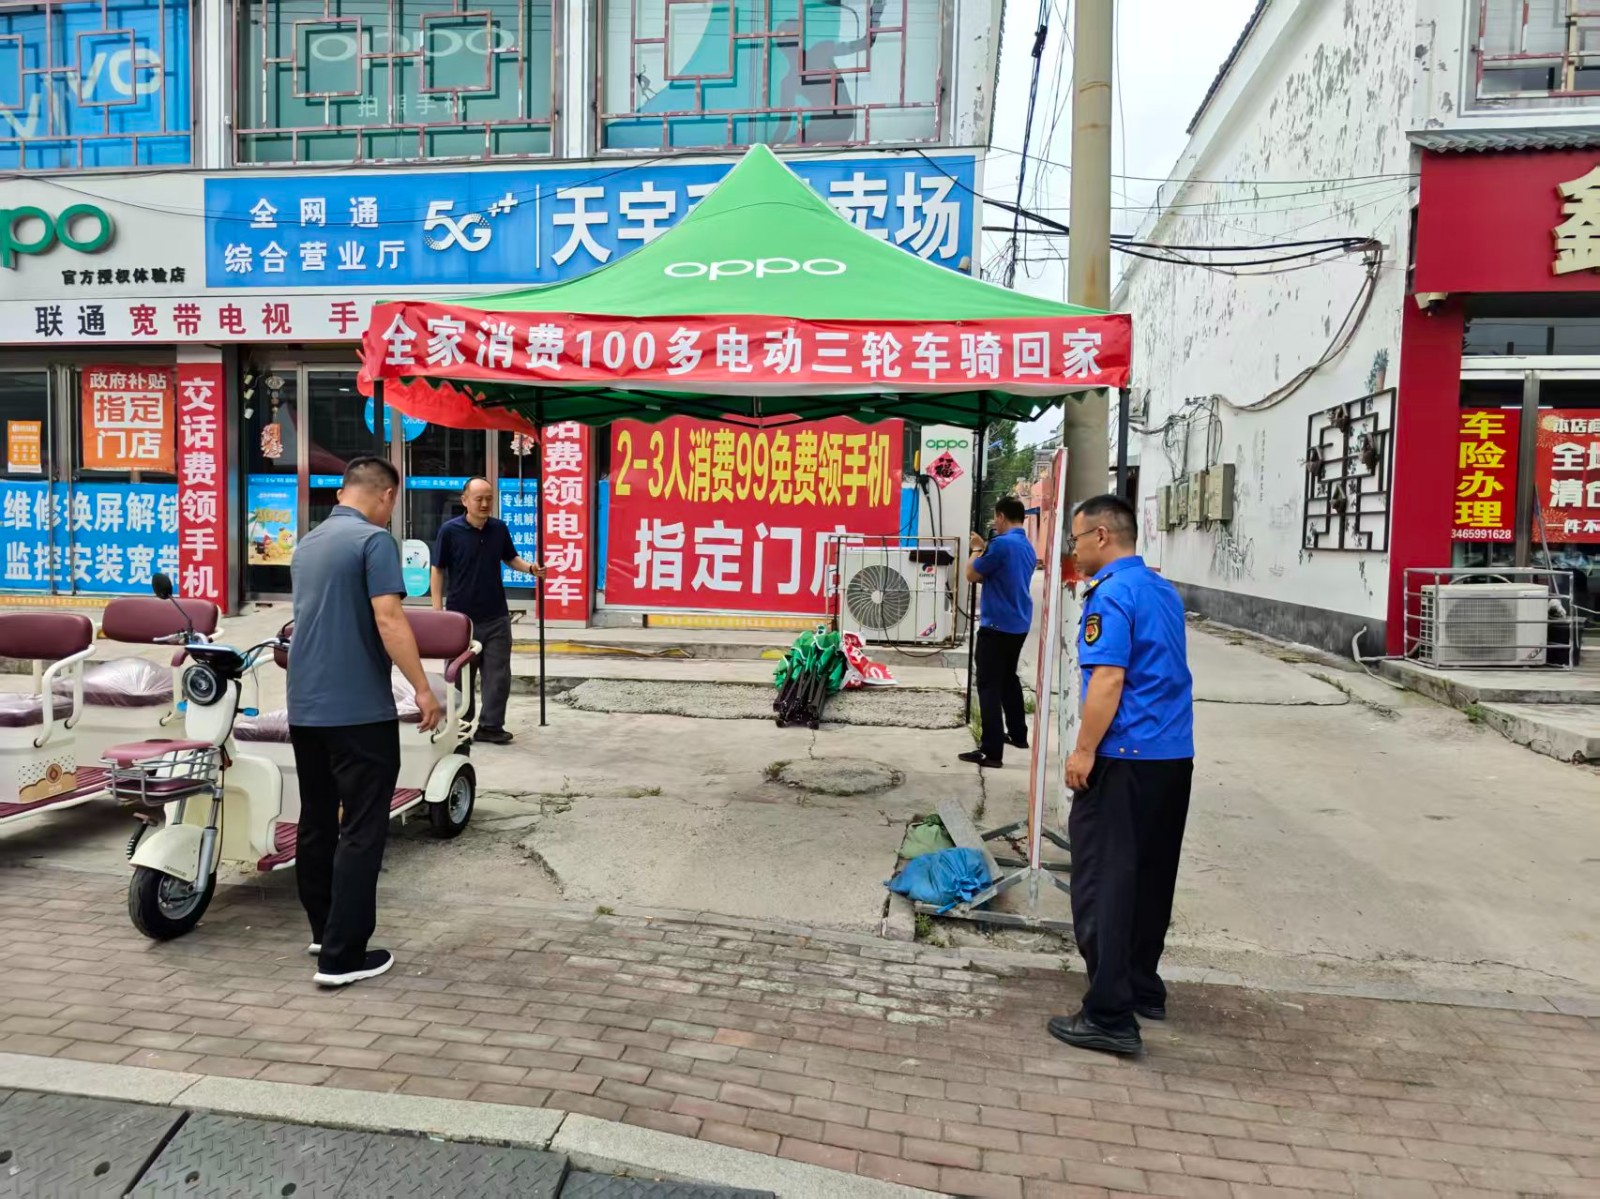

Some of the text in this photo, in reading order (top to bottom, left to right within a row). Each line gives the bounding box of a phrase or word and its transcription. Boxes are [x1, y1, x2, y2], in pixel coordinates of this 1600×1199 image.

[311, 28, 515, 69] oppo
[249, 197, 379, 228] 全网通
[551, 171, 961, 266] 天宇卖场
[224, 240, 406, 274] 综合营业厅
[664, 257, 847, 281] oppo
[61, 267, 186, 286] 官方授权体验店
[381, 312, 1103, 380] 全家消费100多电动三轮车骑回家
[89, 372, 167, 390] 政府补贴
[96, 394, 161, 423] 指定
[96, 430, 162, 459] 门店
[926, 440, 968, 450] oppo
[615, 427, 892, 508] 2-3人消费99免费领手机
[1454, 411, 1507, 528] 车险办理
[180, 377, 219, 598] 交话费领手机
[503, 494, 537, 508] 专业维
[3, 489, 178, 533] 维修换屏解锁
[503, 512, 537, 527] 手机解
[4, 541, 179, 585] 监控安装宽带
